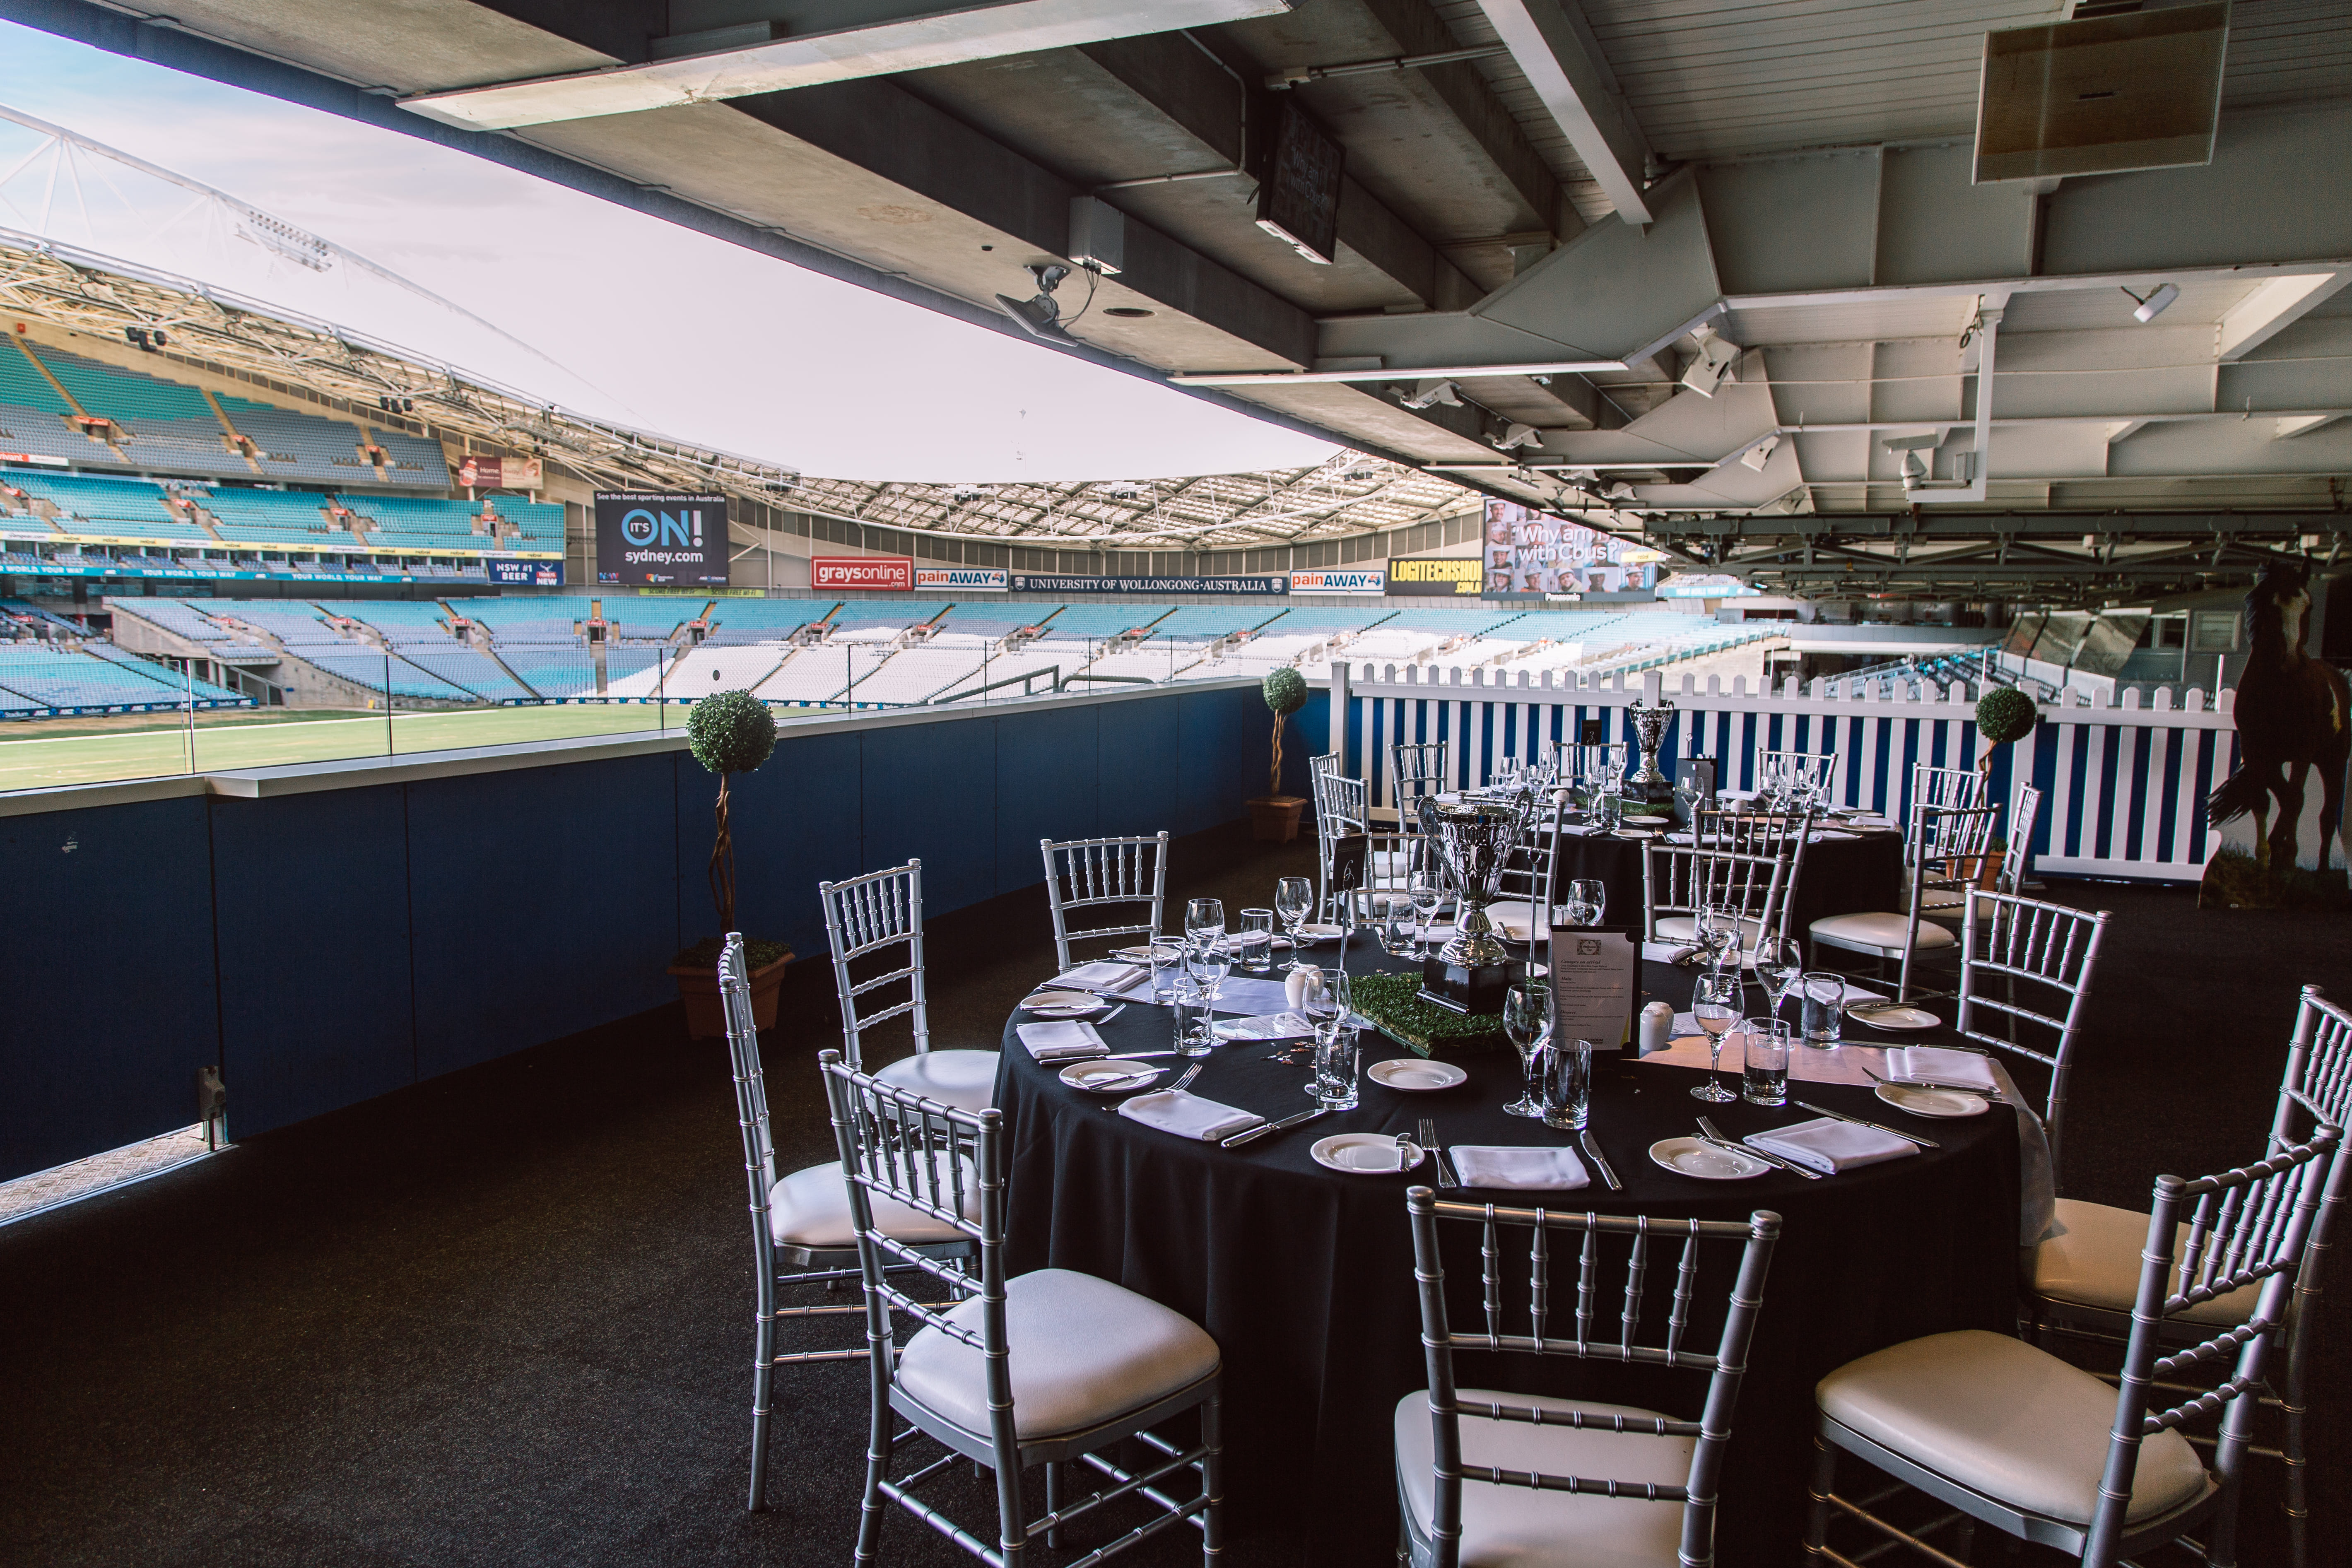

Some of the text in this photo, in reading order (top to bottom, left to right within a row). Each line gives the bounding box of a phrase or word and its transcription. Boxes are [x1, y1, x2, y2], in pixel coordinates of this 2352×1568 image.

[622, 509, 703, 547] ON!
[630, 523, 650, 533] IT'S
[1562, 528, 1593, 542] am
[625, 549, 704, 565] sydney.com
[1518, 544, 1556, 561] with
[496, 564, 533, 573] NSW #1
[819, 565, 906, 582] graysonline
[502, 572, 528, 581] BEER
[918, 571, 991, 584] painAWAY
[1292, 573, 1367, 588] painAWAY
[1030, 579, 1100, 589] UNIVERSITY
[1102, 579, 1117, 589] OF
[1455, 581, 1482, 593] .COM.A
[1545, 593, 1581, 601] Panasonic
[1344, 860, 1353, 882] 6
